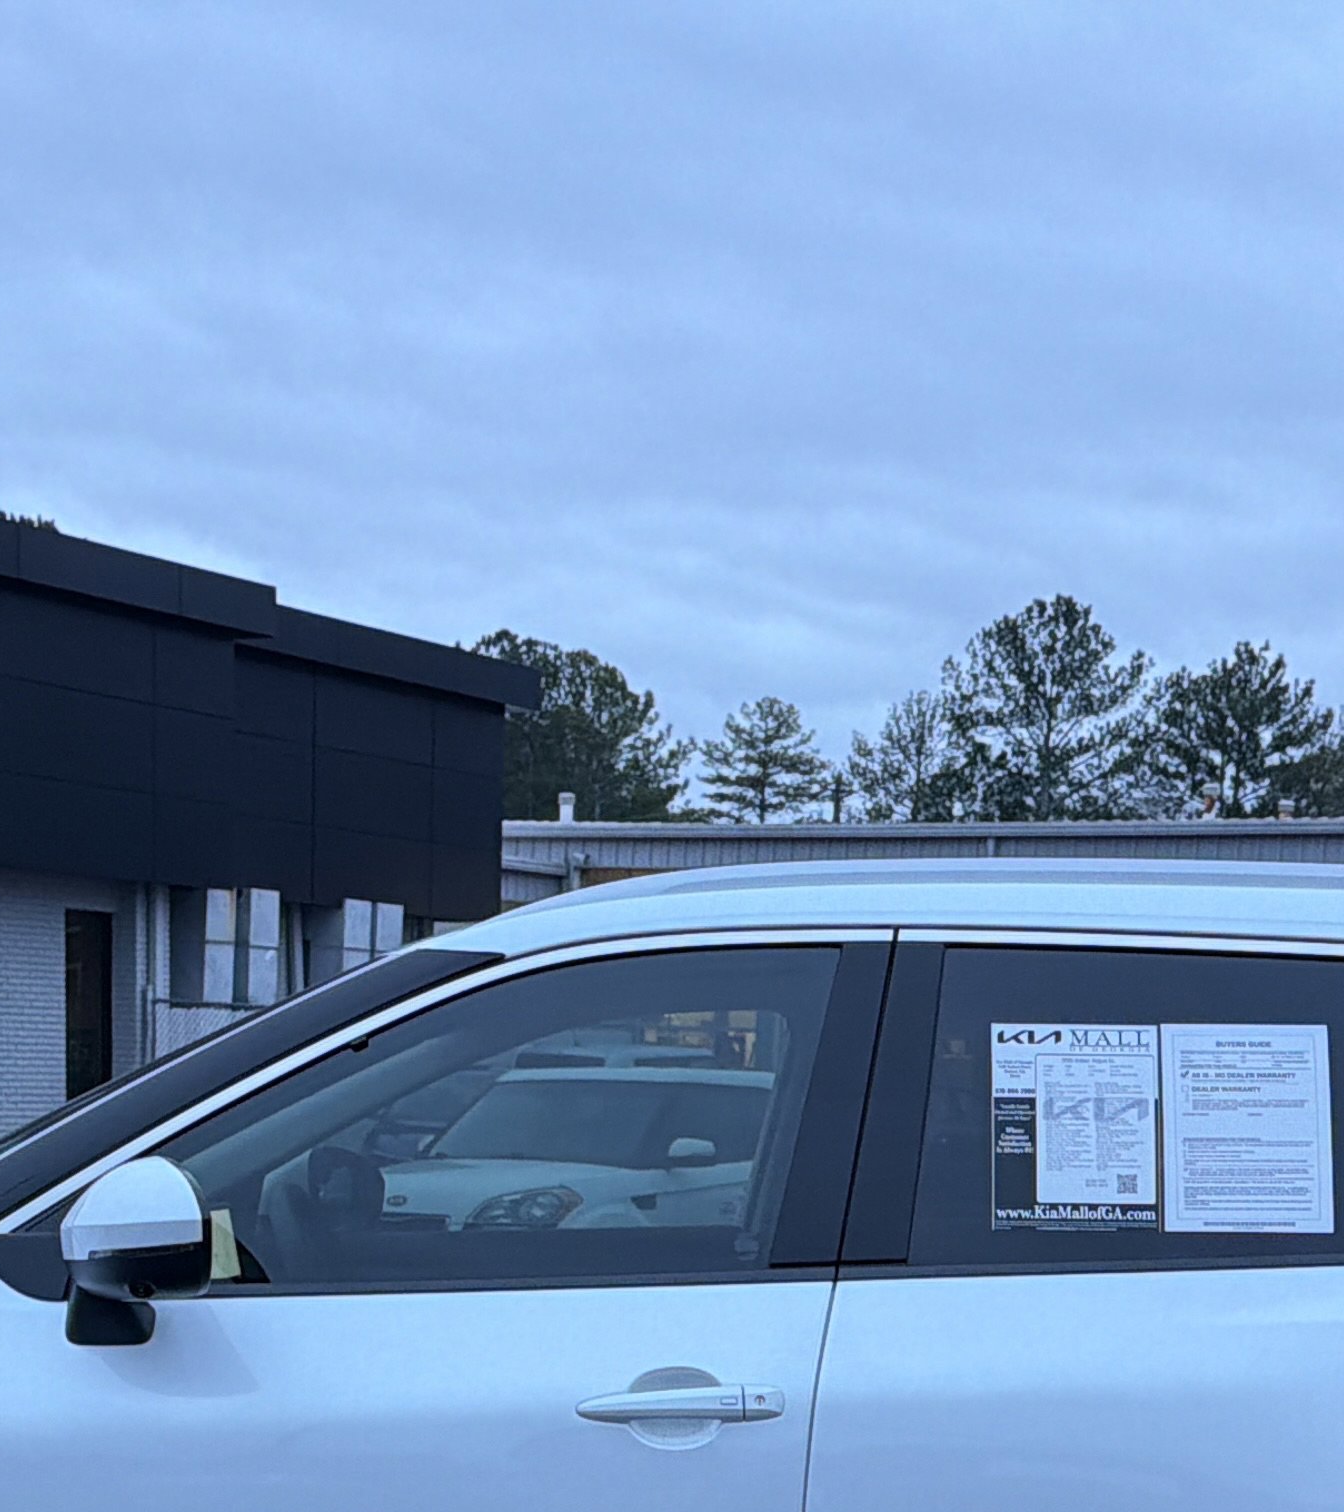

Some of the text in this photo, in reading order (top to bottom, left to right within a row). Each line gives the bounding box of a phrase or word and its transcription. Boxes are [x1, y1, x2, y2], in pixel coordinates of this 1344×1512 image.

[997, 1029, 1150, 1047] KIA MALL
[996, 1204, 1156, 1221] www.KiaMallofGA.com
